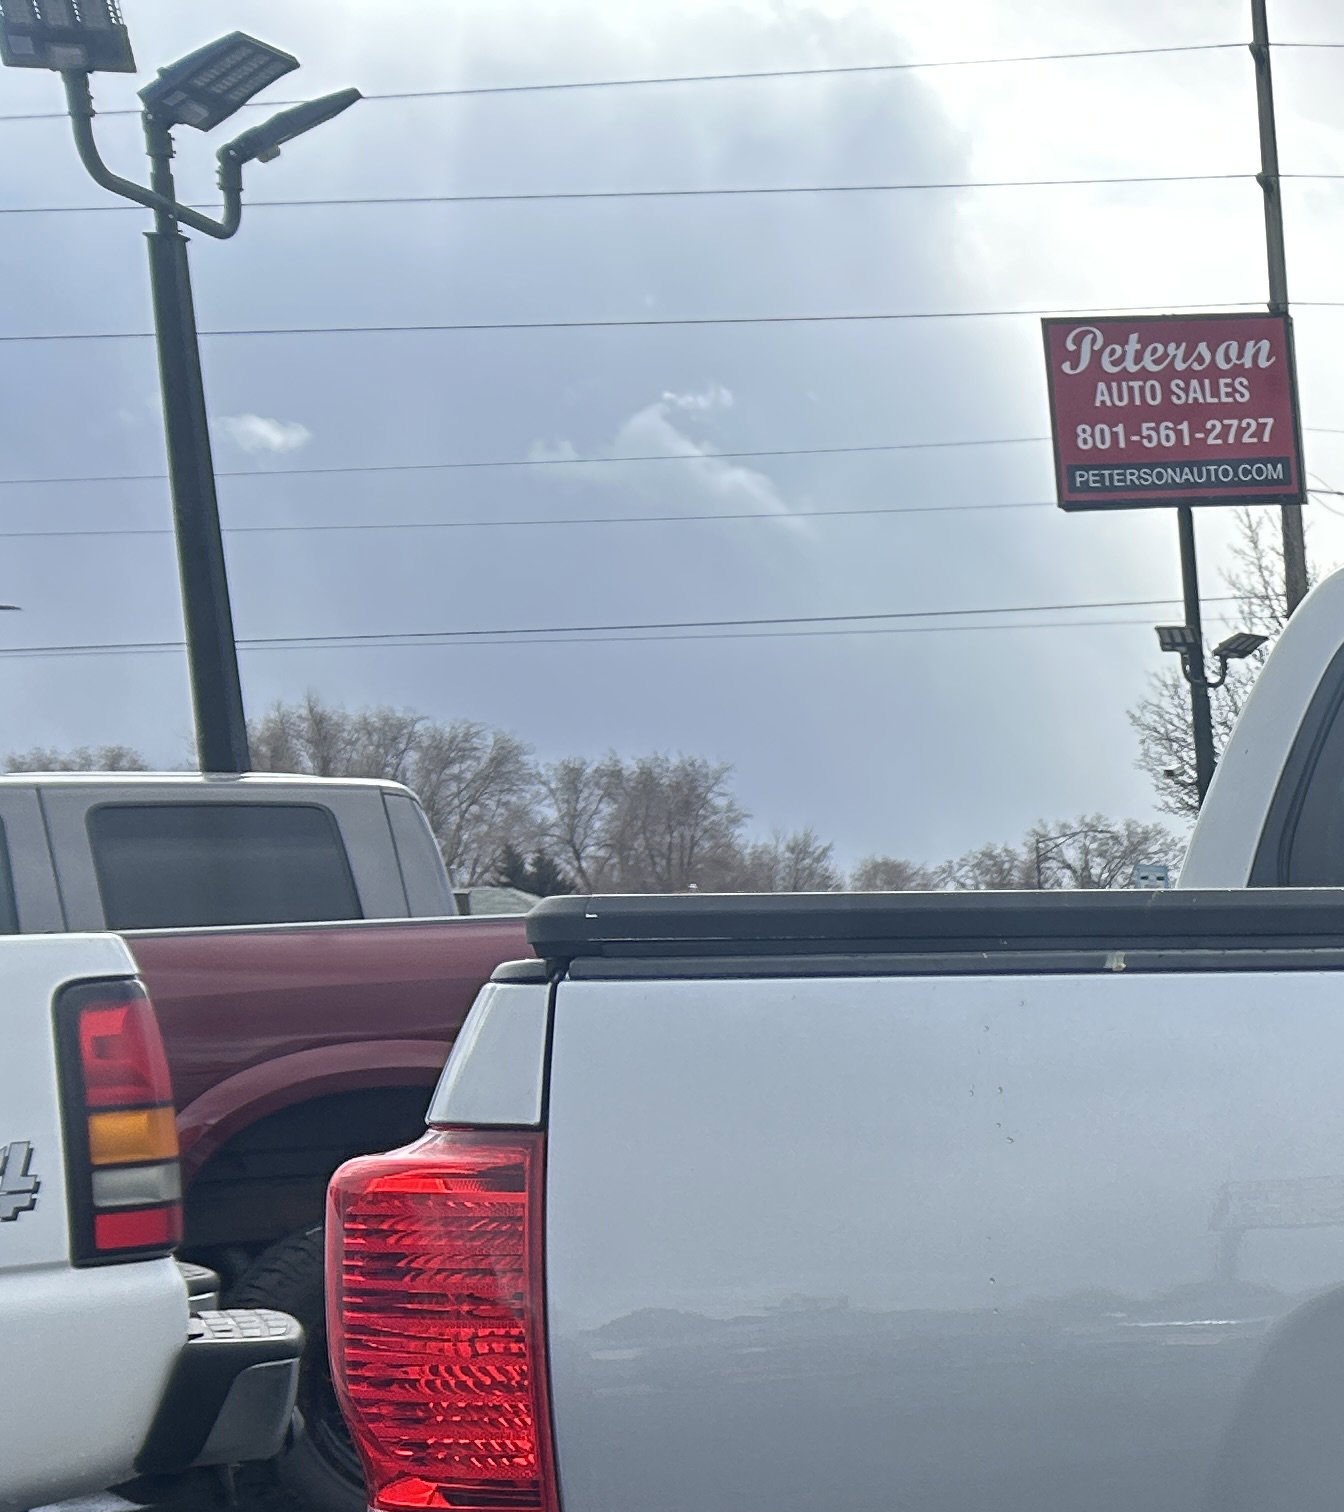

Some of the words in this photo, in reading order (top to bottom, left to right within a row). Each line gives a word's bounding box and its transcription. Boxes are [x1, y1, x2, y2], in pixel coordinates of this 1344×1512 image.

[1060, 326, 1276, 375] Peterson
[1095, 380, 1162, 407] AUTO
[1170, 377, 1250, 405] SALES
[1076, 417, 1274, 450] 801-561-2727
[1075, 463, 1283, 487] PETERSONAUTO.COM
